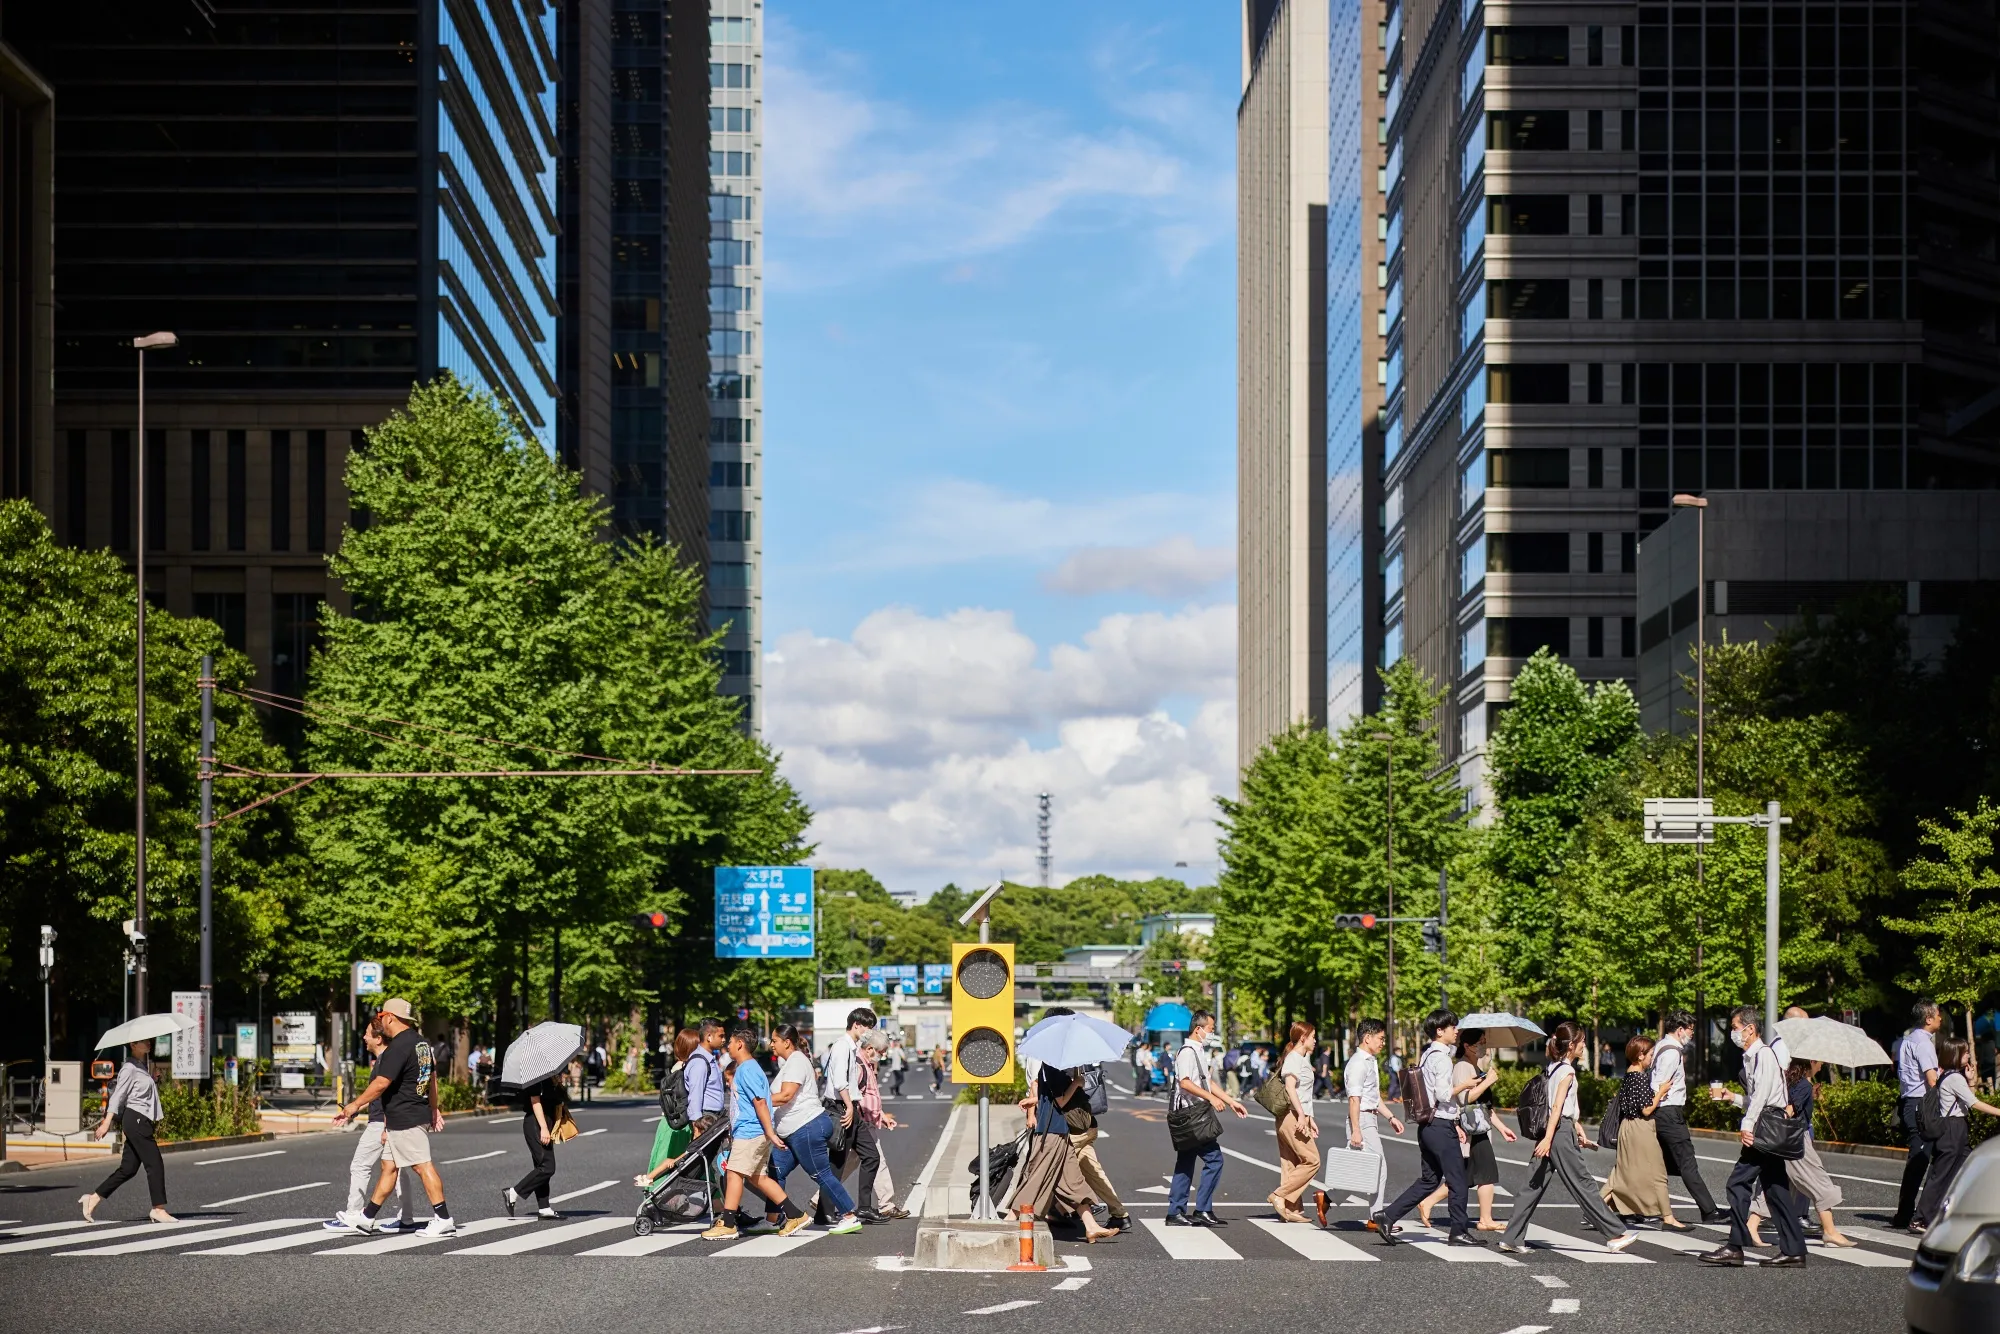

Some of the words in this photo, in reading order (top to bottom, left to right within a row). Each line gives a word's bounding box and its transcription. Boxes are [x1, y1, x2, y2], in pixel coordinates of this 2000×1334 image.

[746, 870, 783, 882] 大手門
[719, 893, 755, 905] 五反田
[719, 914, 755, 926] 日比谷
